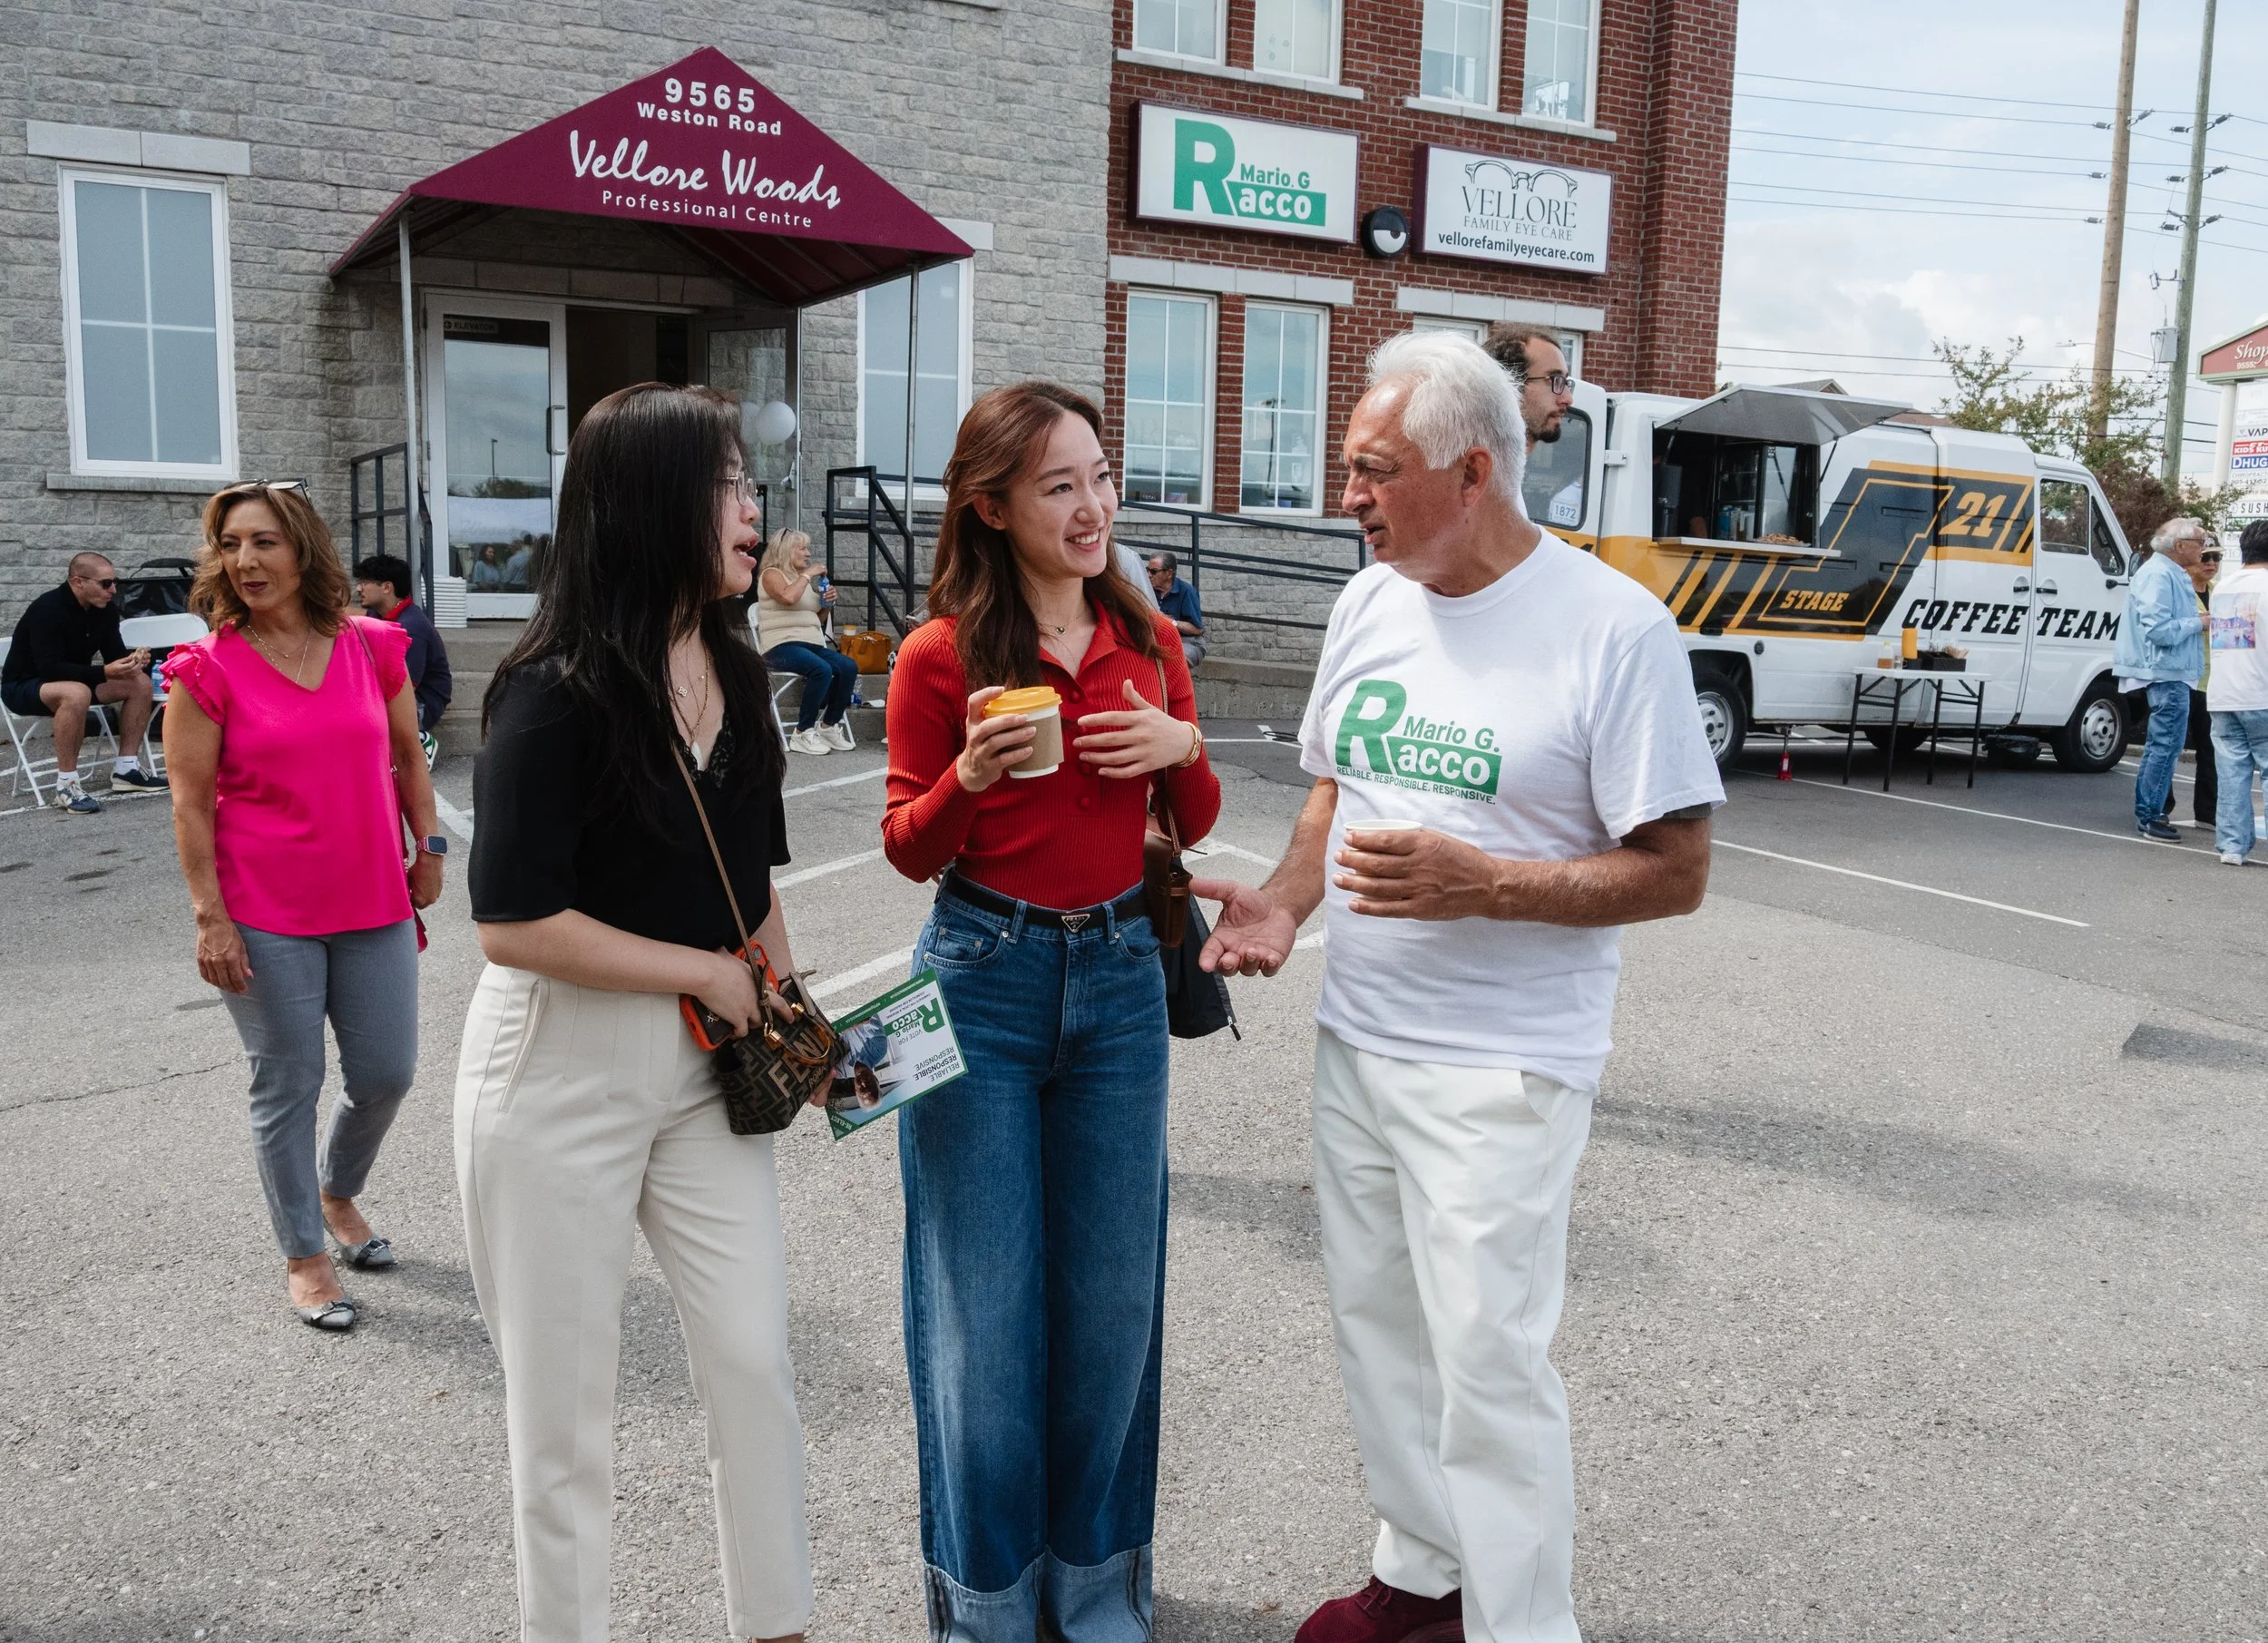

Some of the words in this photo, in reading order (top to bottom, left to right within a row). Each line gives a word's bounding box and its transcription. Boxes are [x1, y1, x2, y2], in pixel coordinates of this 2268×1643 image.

[665, 77, 755, 112] 9565
[637, 102, 718, 127] Weston
[728, 114, 781, 135] Road
[570, 130, 709, 191] Vellore
[722, 150, 841, 210] Woods
[602, 191, 736, 219] Professional
[746, 207, 812, 228] Centre
[1461, 186, 1578, 229] VELLORE
[1463, 215, 1511, 232] FAMILY
[1515, 222, 1538, 237] EYE
[1541, 227, 1573, 241] CARE
[1438, 231, 1595, 263] vellorefamilyeyecare.com
[1555, 504, 1577, 520] 1872
[1940, 492, 2007, 537] 21
[1779, 589, 1849, 611] STAGE
[1901, 599, 2028, 635] COFFEE
[2035, 607, 2121, 641] TEAM
[1334, 680, 1491, 786] Racco
[1403, 715, 1467, 745] Mario
[1474, 728, 1500, 752] G.
[1336, 766, 1373, 781] RELIABLE.
[1374, 771, 1431, 792] RESPONSIBLE.
[1432, 785, 1496, 805] RESPONSIVE.
[898, 1036, 909, 1045] FOR
[902, 1021, 921, 1032] Mario
[910, 1029, 923, 1038] VOTE
